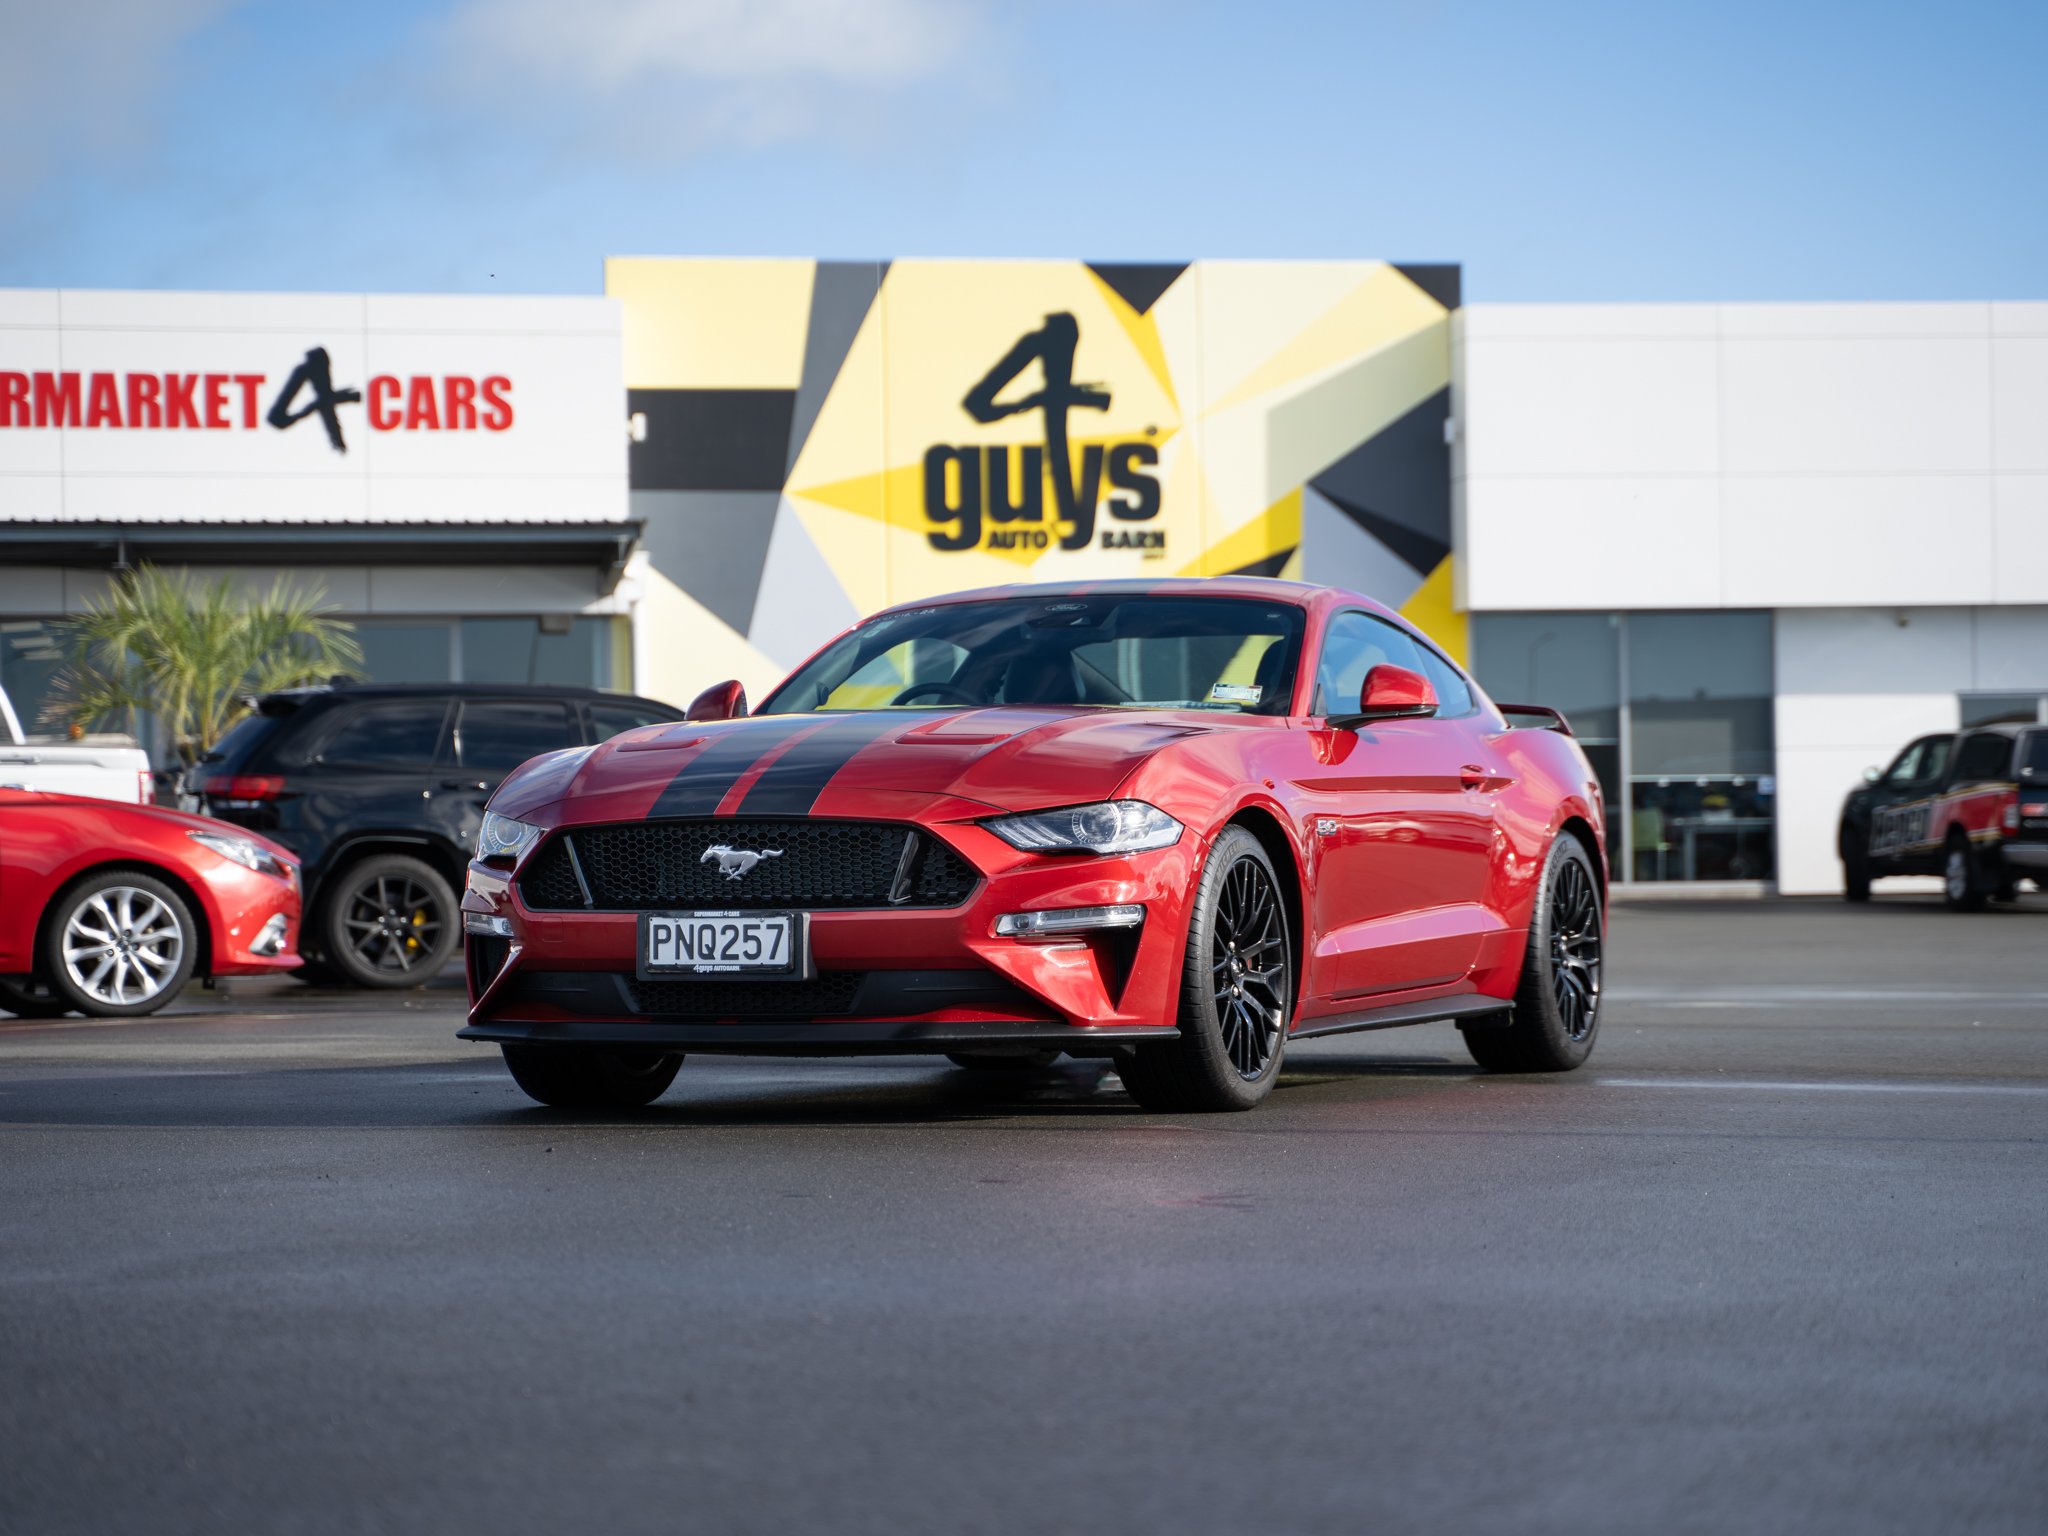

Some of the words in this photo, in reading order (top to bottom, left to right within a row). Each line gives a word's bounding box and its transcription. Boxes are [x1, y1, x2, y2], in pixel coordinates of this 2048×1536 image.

[0, 371, 266, 429] RMARKET
[267, 346, 361, 453] 4
[367, 374, 514, 432] CARS
[962, 312, 1111, 495] 4
[924, 441, 1163, 551] guys
[987, 530, 1048, 549] AUTO
[1101, 530, 1165, 549] BARN
[652, 923, 784, 961] PNQ257
